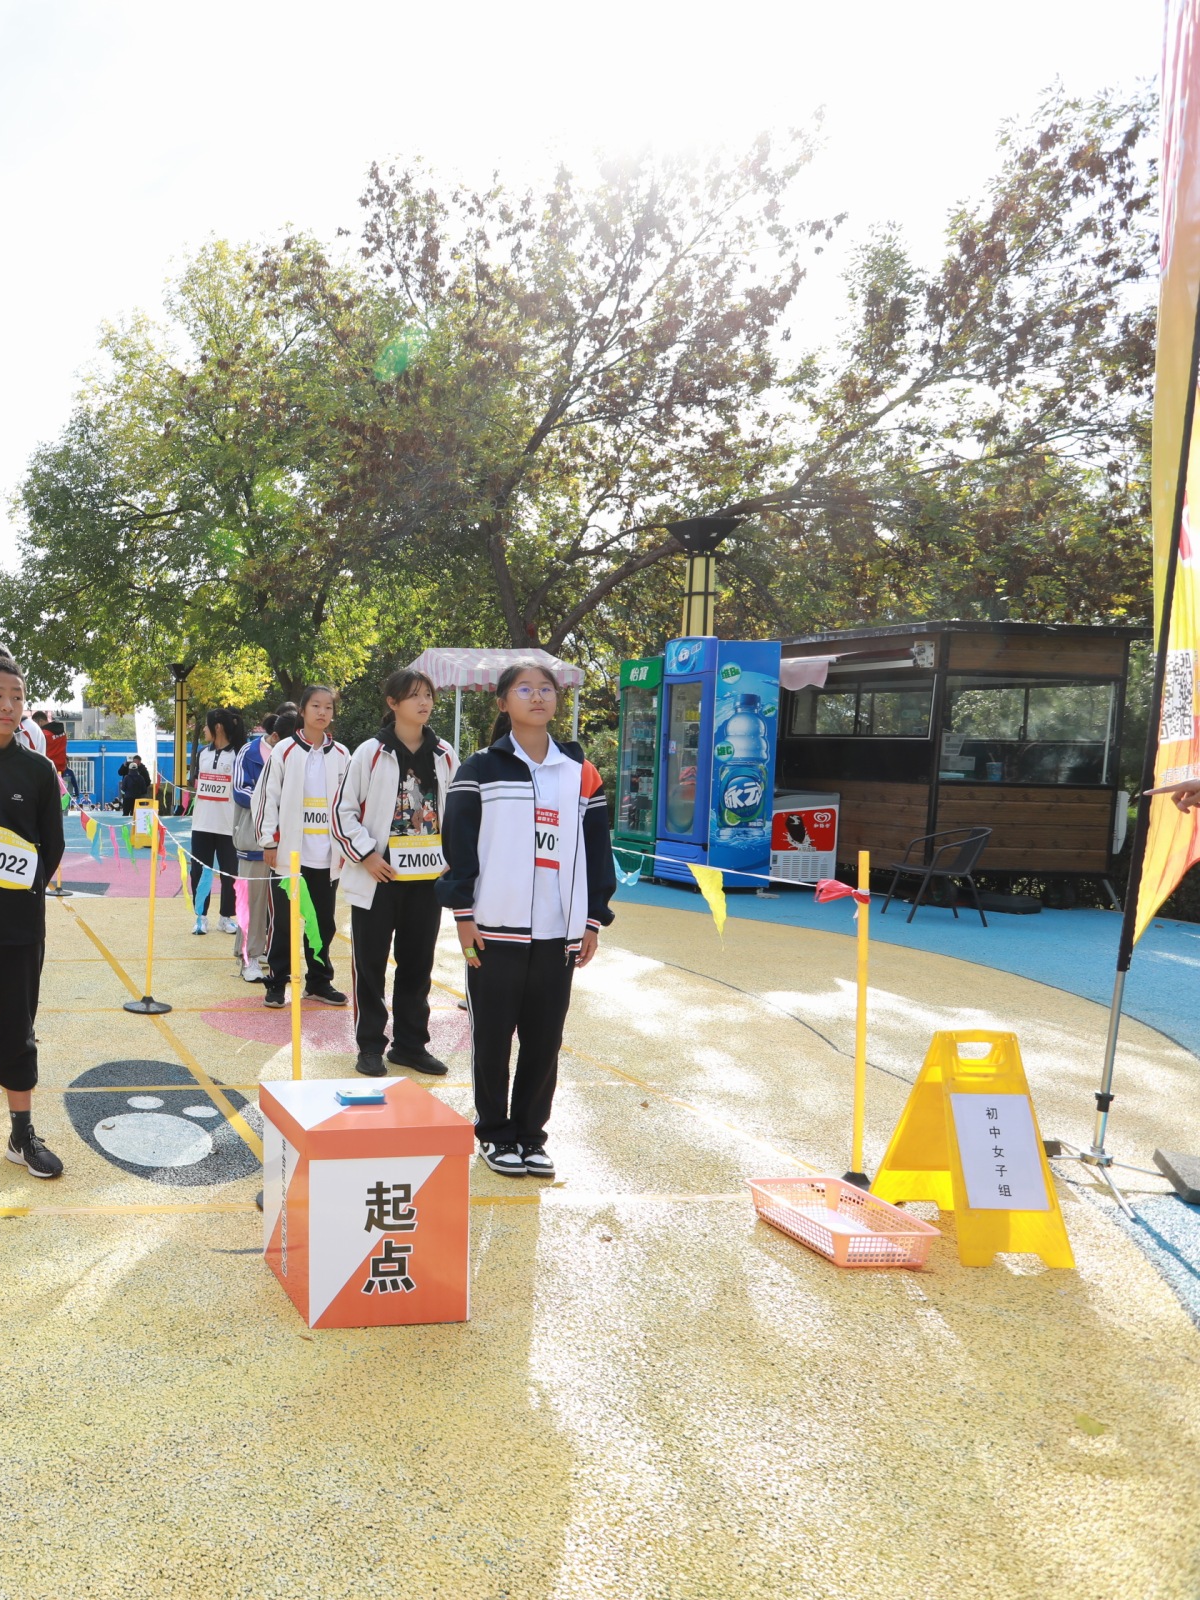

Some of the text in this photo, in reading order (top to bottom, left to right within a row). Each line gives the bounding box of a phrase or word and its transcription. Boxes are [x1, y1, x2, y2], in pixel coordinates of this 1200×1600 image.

[200, 783, 227, 794] ZW027
[398, 853, 443, 868] ZM001
[985, 1107, 1012, 1197] 初中女子组
[362, 1181, 417, 1294] 起点
